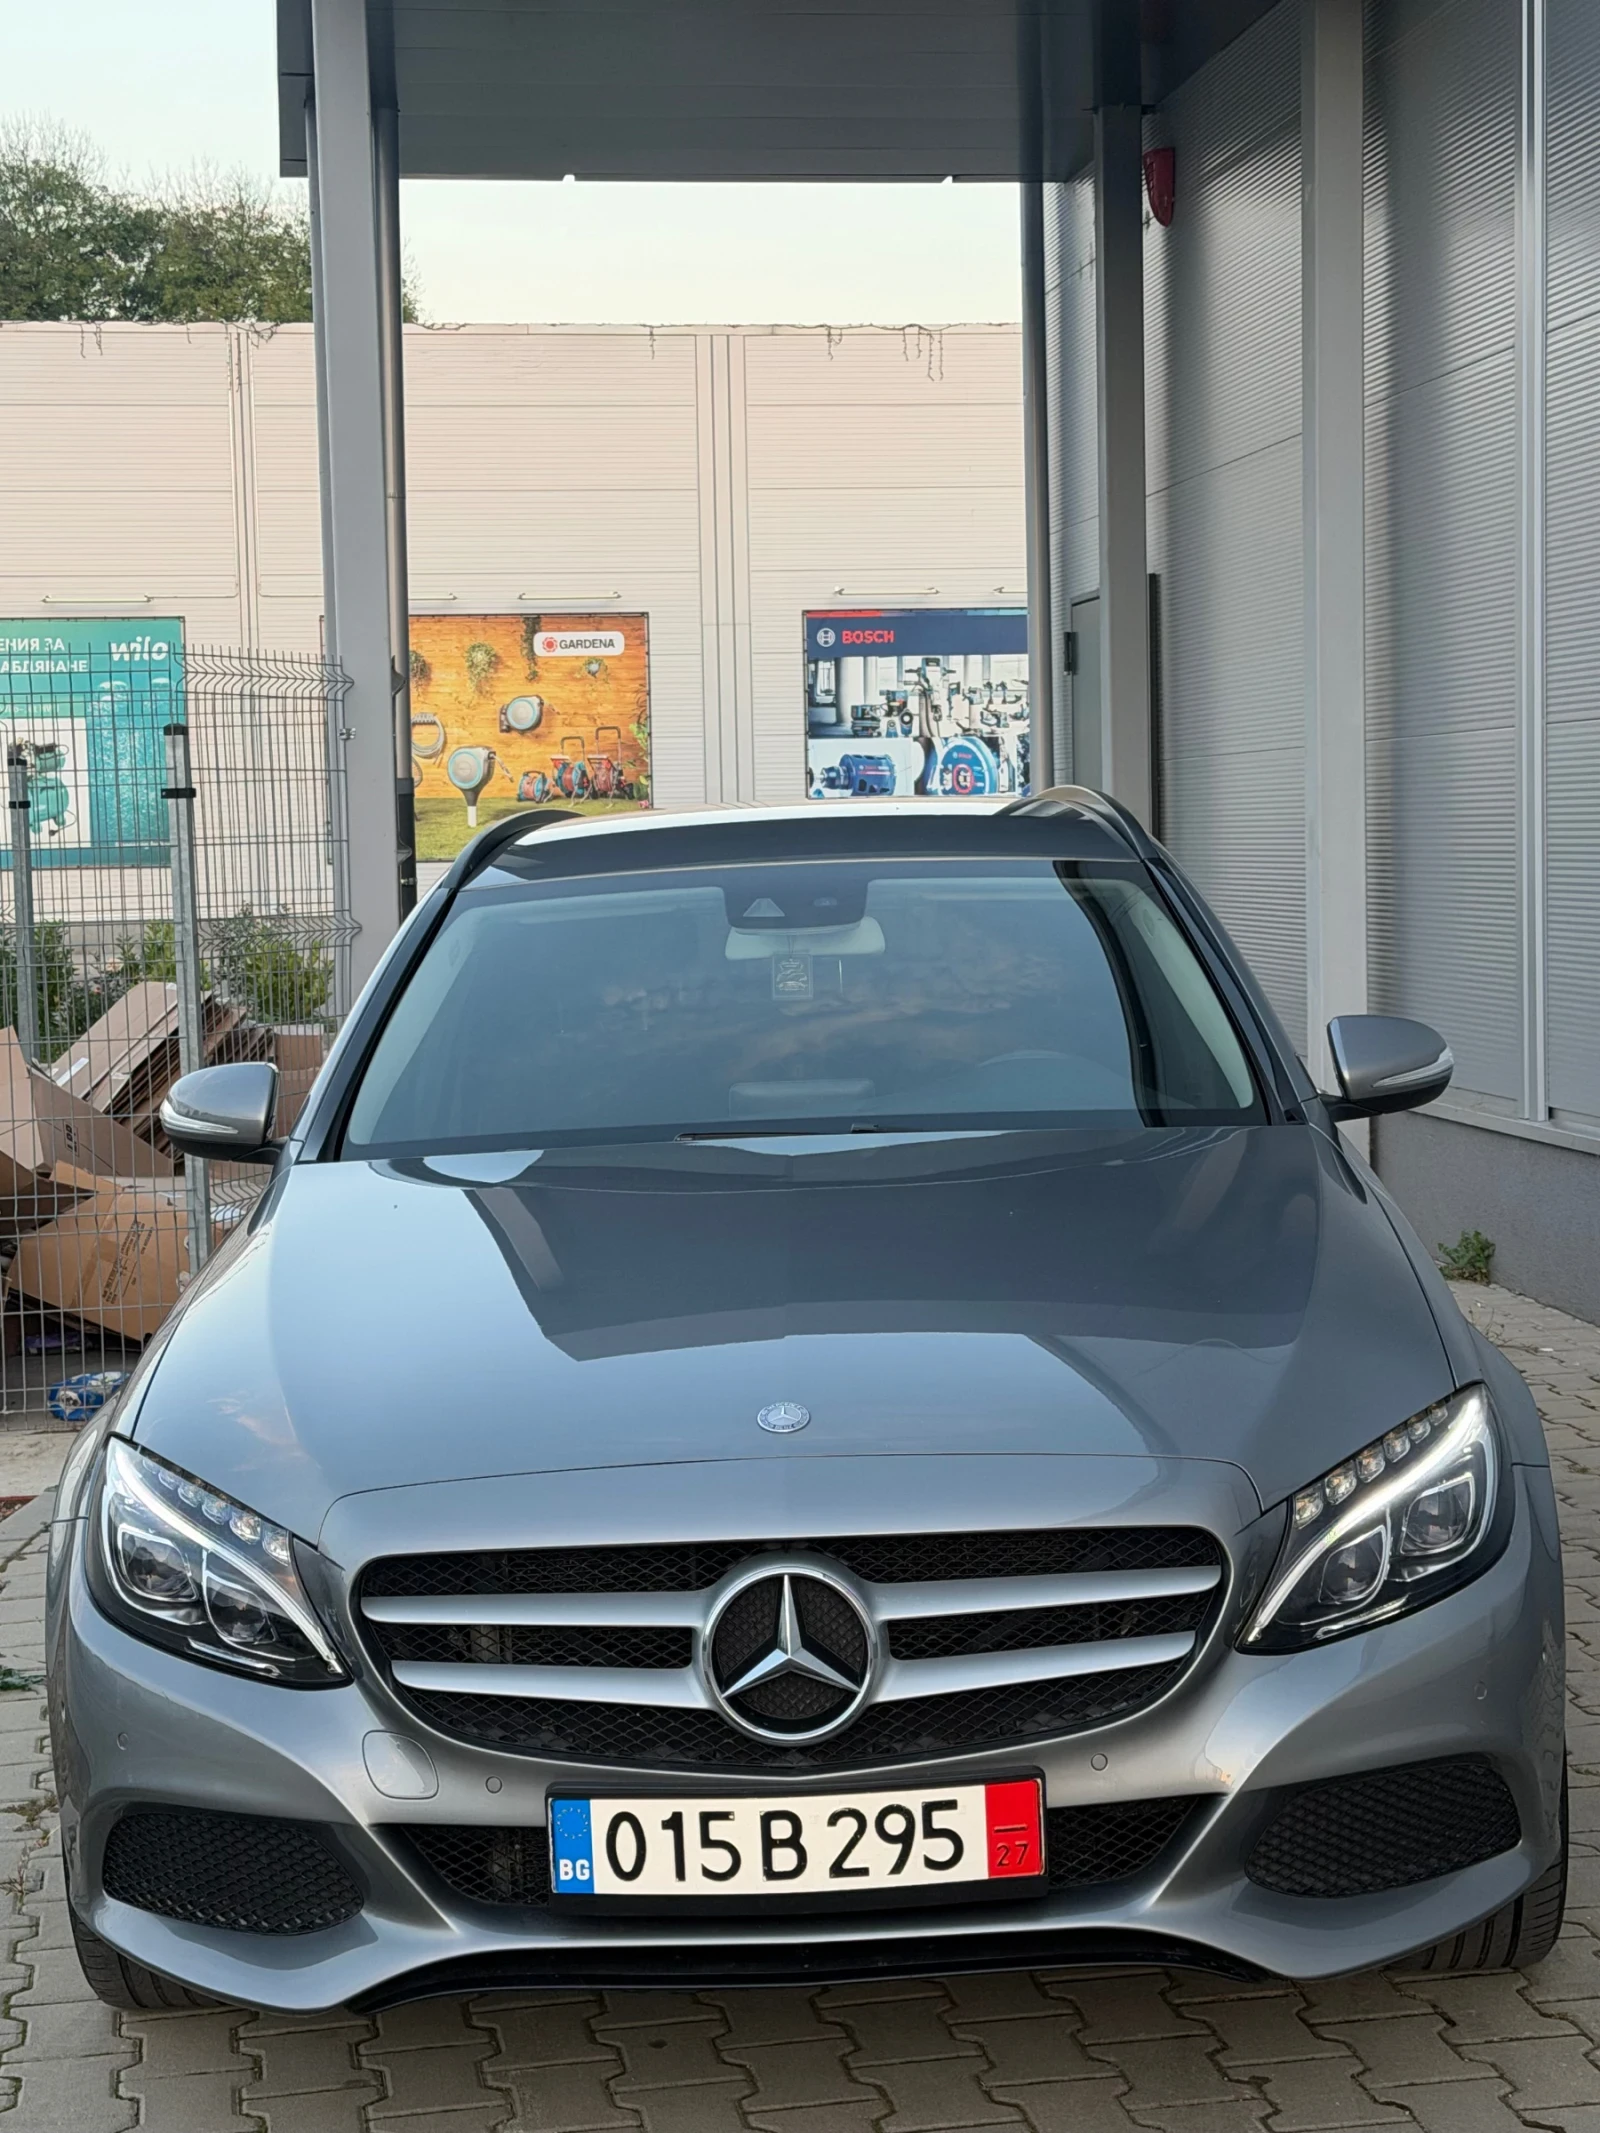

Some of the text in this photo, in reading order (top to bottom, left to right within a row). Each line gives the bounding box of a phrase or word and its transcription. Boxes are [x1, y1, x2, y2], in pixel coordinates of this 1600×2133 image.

[44, 637, 65, 651] ЗА
[110, 636, 169, 661] wilo
[559, 639, 615, 650] GARDENA
[842, 630, 894, 644] BOSCH
[605, 1810, 742, 1882] 015
[826, 1799, 965, 1878] 295
[996, 1841, 1029, 1867] 27
[559, 1858, 590, 1881] BG
